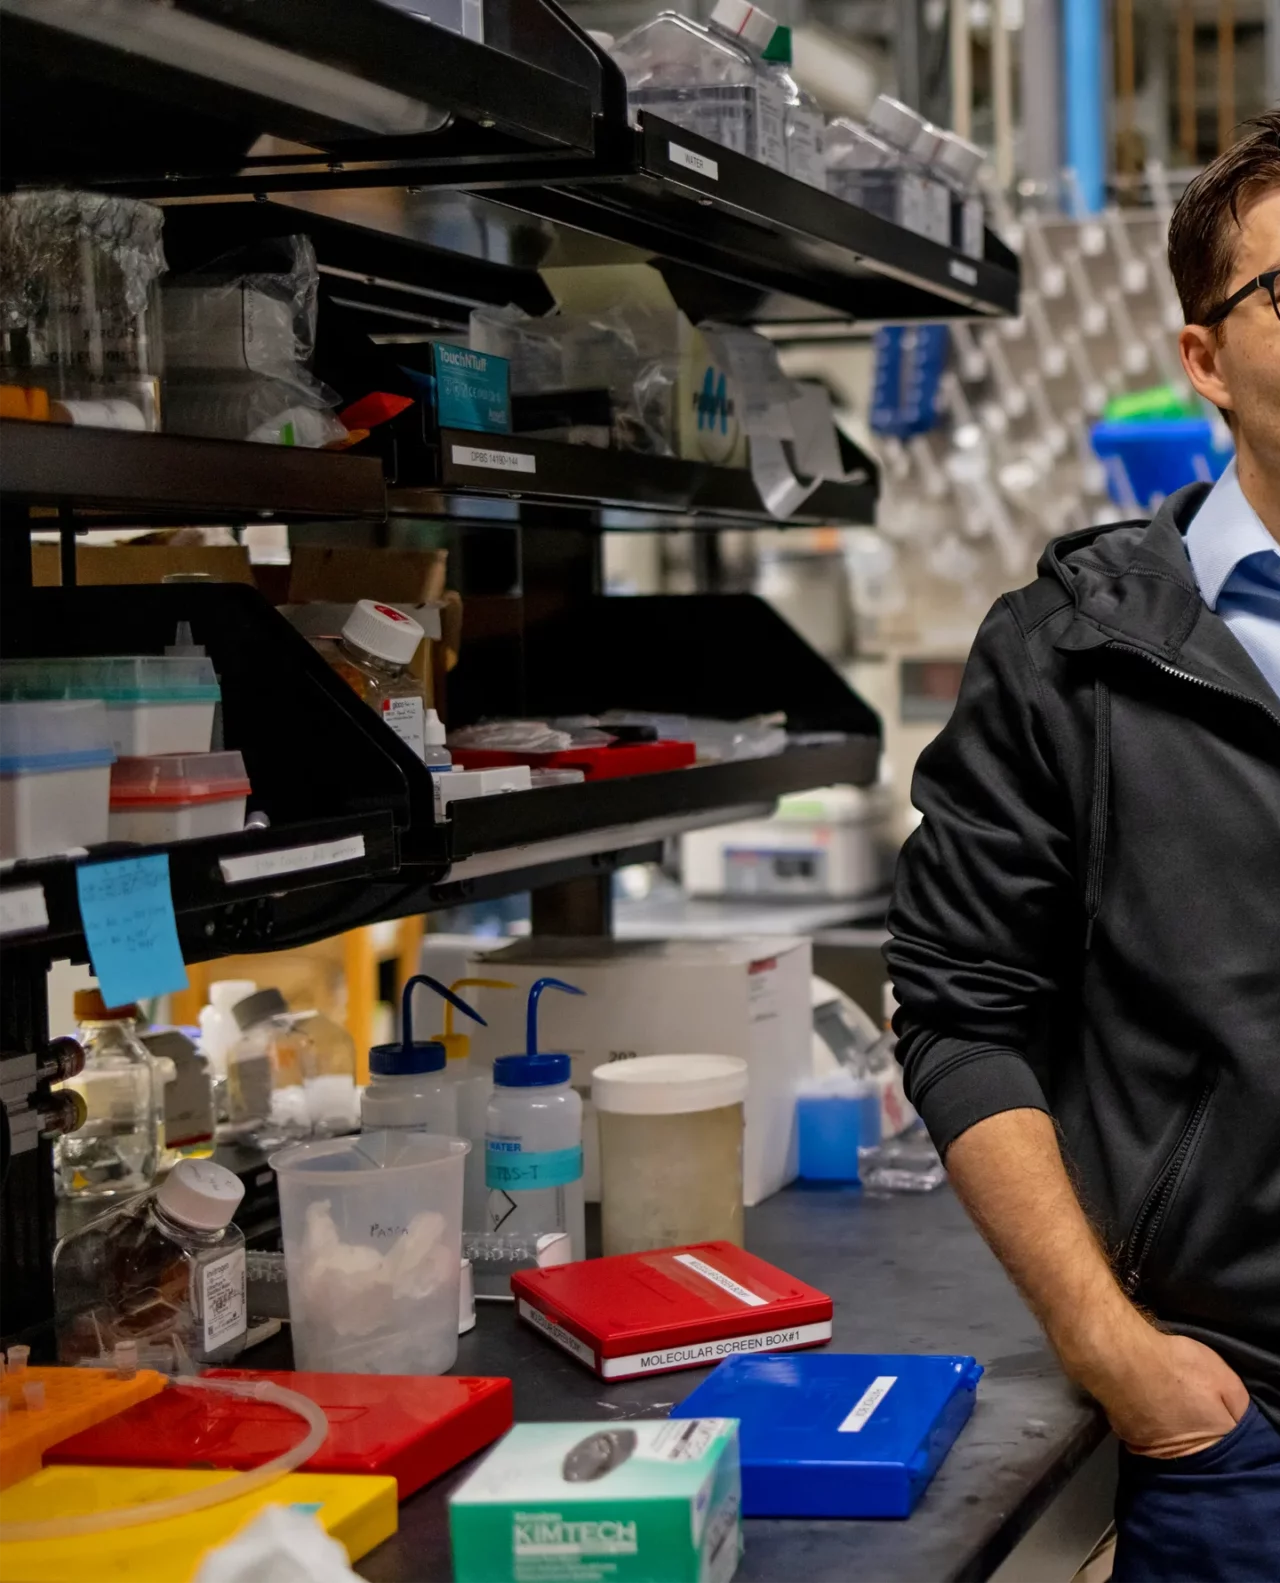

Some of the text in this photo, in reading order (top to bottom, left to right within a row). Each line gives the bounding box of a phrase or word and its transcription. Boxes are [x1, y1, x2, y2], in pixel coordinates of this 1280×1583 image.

[685, 153, 704, 169] WATER
[439, 347, 487, 371] TouchNTuff
[471, 451, 488, 463] DPBS
[496, 1165, 538, 1182] TBS-T
[640, 1330, 800, 1368] MOLECULAR SCREEN BOX#1
[514, 1520, 637, 1544] KIMTECH
